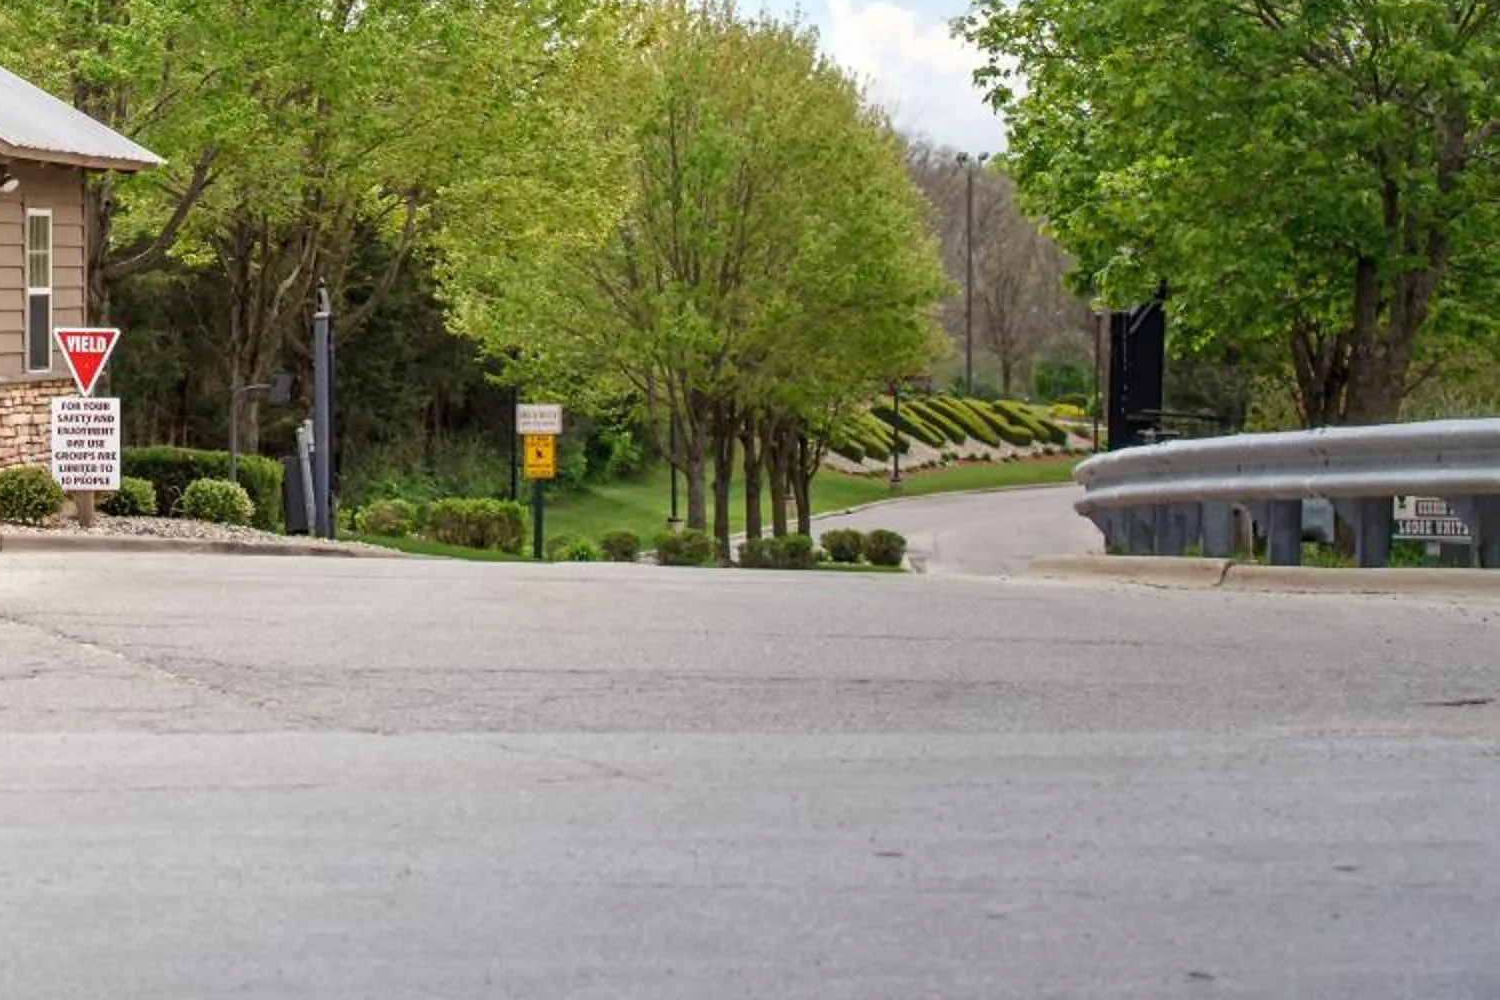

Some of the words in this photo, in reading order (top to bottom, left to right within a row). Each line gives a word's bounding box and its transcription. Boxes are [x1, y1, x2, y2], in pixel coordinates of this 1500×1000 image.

[66, 335, 107, 353] YIELD
[61, 401, 81, 411] FOR
[83, 401, 111, 411] YOUR
[57, 414, 92, 423] SAFETY
[93, 414, 115, 423] AND
[57, 427, 115, 436] ENJOYMENT
[66, 439, 85, 448] DAY
[87, 439, 105, 448] USE
[55, 451, 96, 461] GROUPS
[97, 451, 117, 461] ARE
[59, 463, 98, 473] LIMITED
[100, 463, 113, 473] TO
[61, 476, 73, 485] 10
[74, 476, 111, 485] PEOPLE
